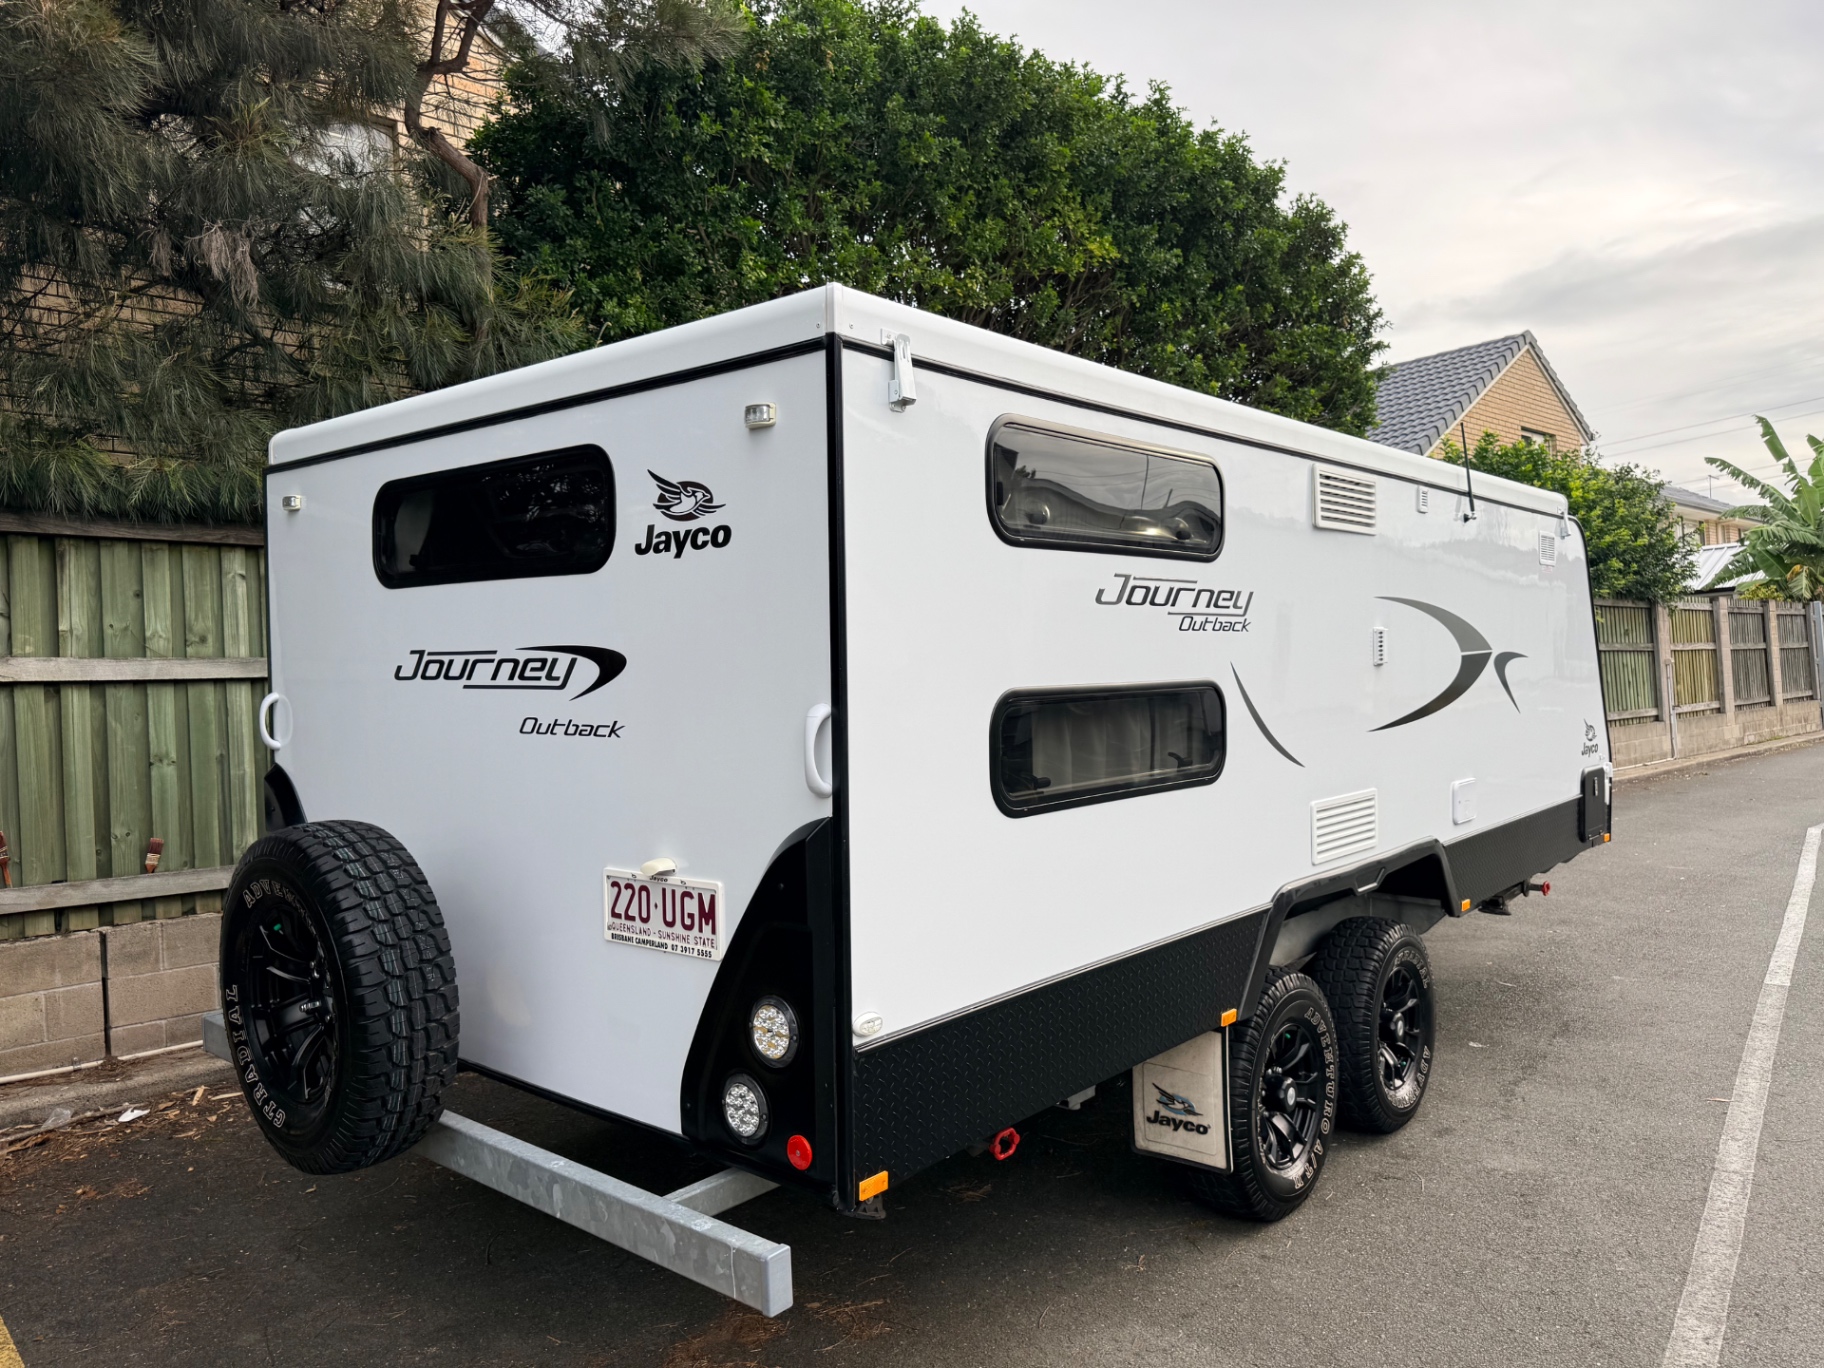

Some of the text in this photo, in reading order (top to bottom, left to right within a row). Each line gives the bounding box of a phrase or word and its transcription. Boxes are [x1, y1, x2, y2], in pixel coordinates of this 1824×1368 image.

[634, 524, 732, 559] Jayco
[1095, 573, 1254, 617] Journey
[1178, 615, 1251, 632] Outback
[394, 650, 577, 690] Journey
[519, 717, 625, 738] Outback
[1581, 742, 1598, 757] Jayco
[611, 921, 652, 937] QUEENSLAND
[658, 929, 691, 945] SUNSHINE
[694, 935, 715, 950] STATE
[680, 946, 695, 955] 3917
[1304, 1006, 1336, 1135] ADVENTURO
[1146, 1110, 1208, 1135] Jayco
